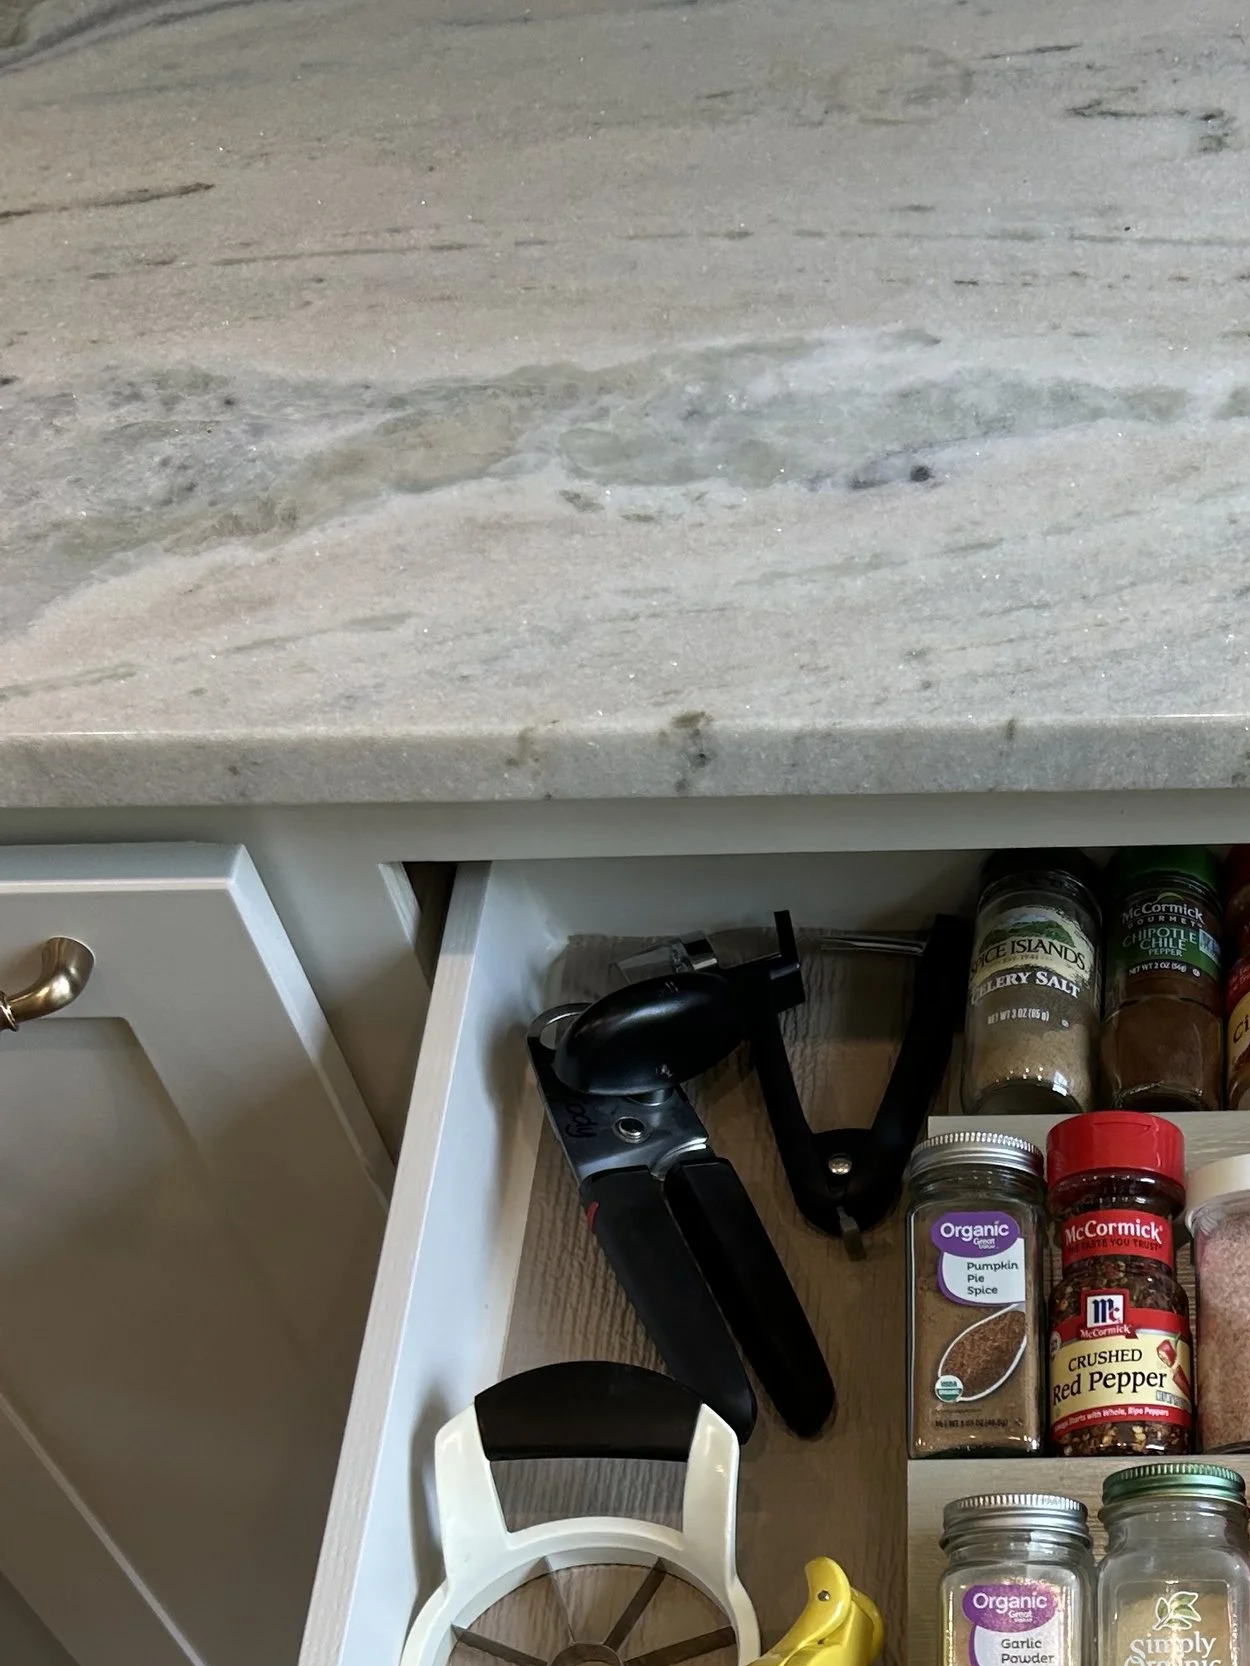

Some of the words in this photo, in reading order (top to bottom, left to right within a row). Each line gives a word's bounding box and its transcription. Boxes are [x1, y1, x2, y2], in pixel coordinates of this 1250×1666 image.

[1122, 902, 1206, 926] McCormick
[1127, 915, 1205, 930] GOURMET
[1122, 928, 1196, 949] CHIPOTLE
[1140, 938, 1187, 952] CHILE
[1148, 948, 1184, 958] PEPPER
[940, 1222, 1010, 1242] Organic
[1064, 1220, 1163, 1246] McCormick
[967, 1261, 1019, 1272] Pumpkin
[967, 1274, 985, 1284] Pie
[967, 1286, 998, 1297] Spice
[1079, 1325, 1132, 1340] McCormick
[1067, 1349, 1143, 1373] CRUSHED
[1053, 1375, 1081, 1407] Red
[1089, 1370, 1167, 1397] Pepper
[973, 1591, 1048, 1615] Organic
[1001, 1639, 1042, 1650] Garlic
[1001, 1653, 1055, 1666] Powder
